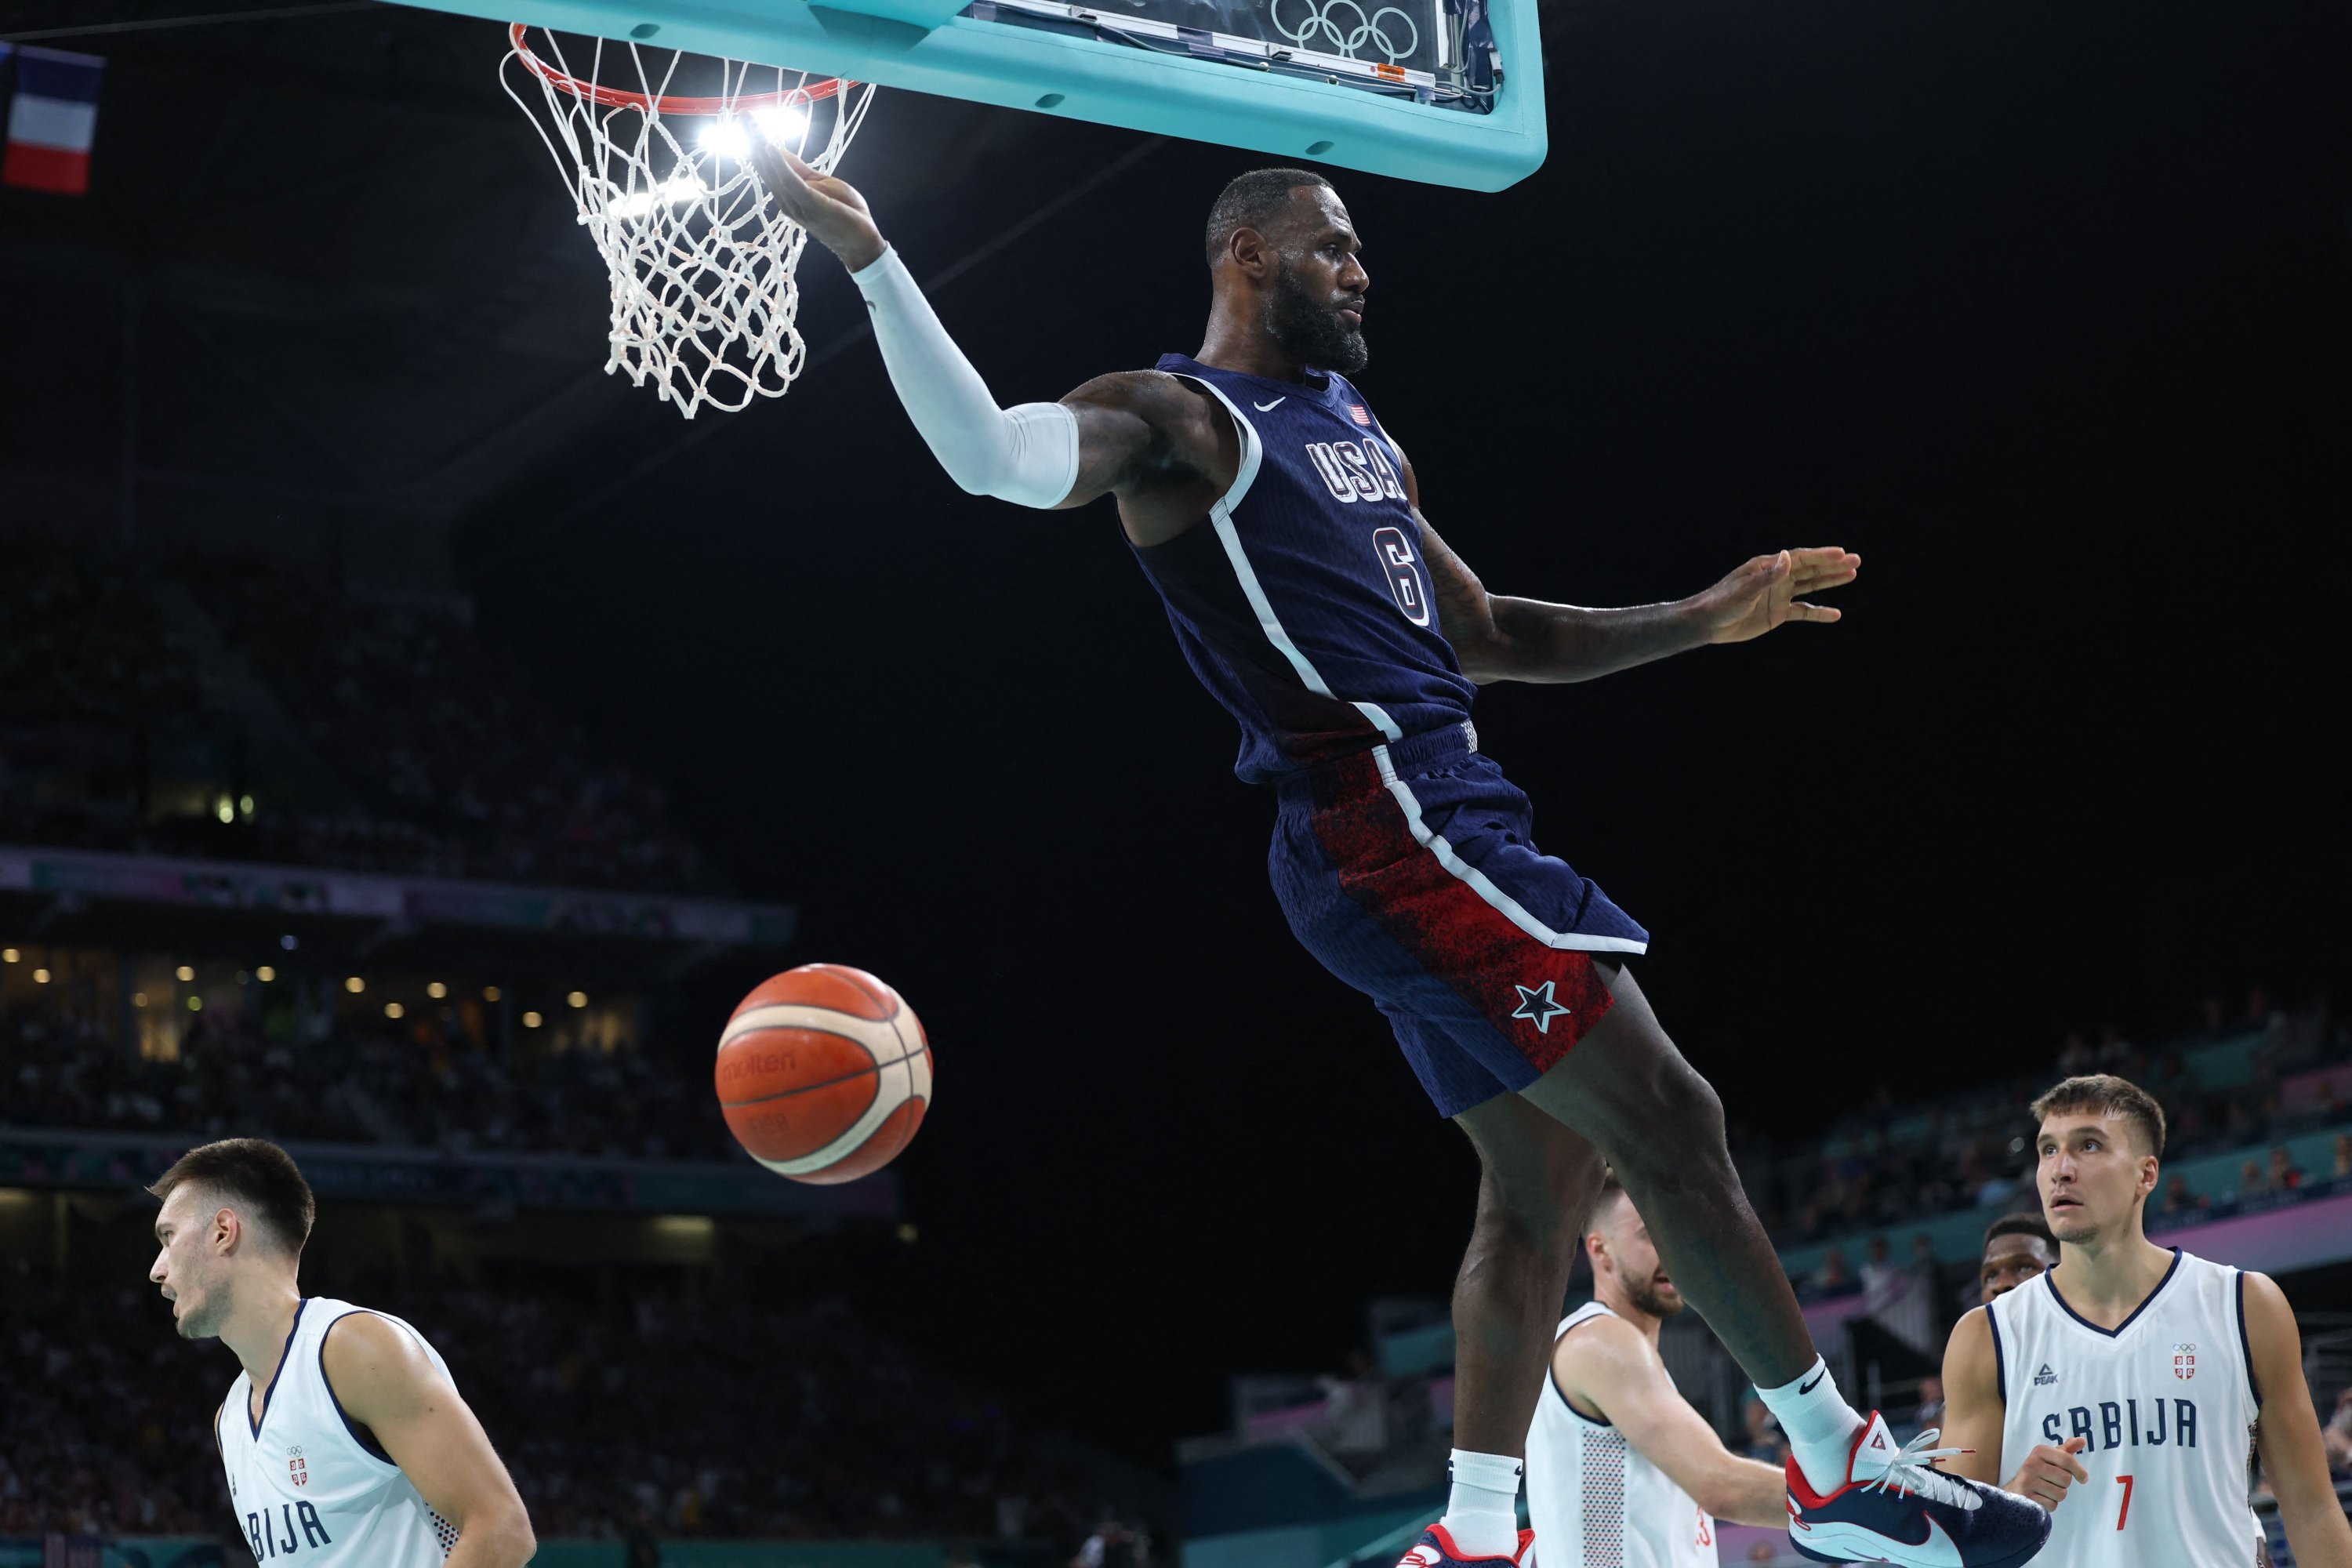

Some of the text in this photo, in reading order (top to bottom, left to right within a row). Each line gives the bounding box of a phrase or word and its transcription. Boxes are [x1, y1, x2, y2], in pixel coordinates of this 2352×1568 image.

[1305, 437, 1408, 503] USA
[1372, 526, 1430, 627] 6
[721, 1050, 797, 1082] molten
[2034, 1374, 2059, 1386] PEAK
[2042, 1398, 2197, 1454] SRBIJA
[2115, 1475, 2133, 1531] 7
[242, 1500, 332, 1563] BIJA
